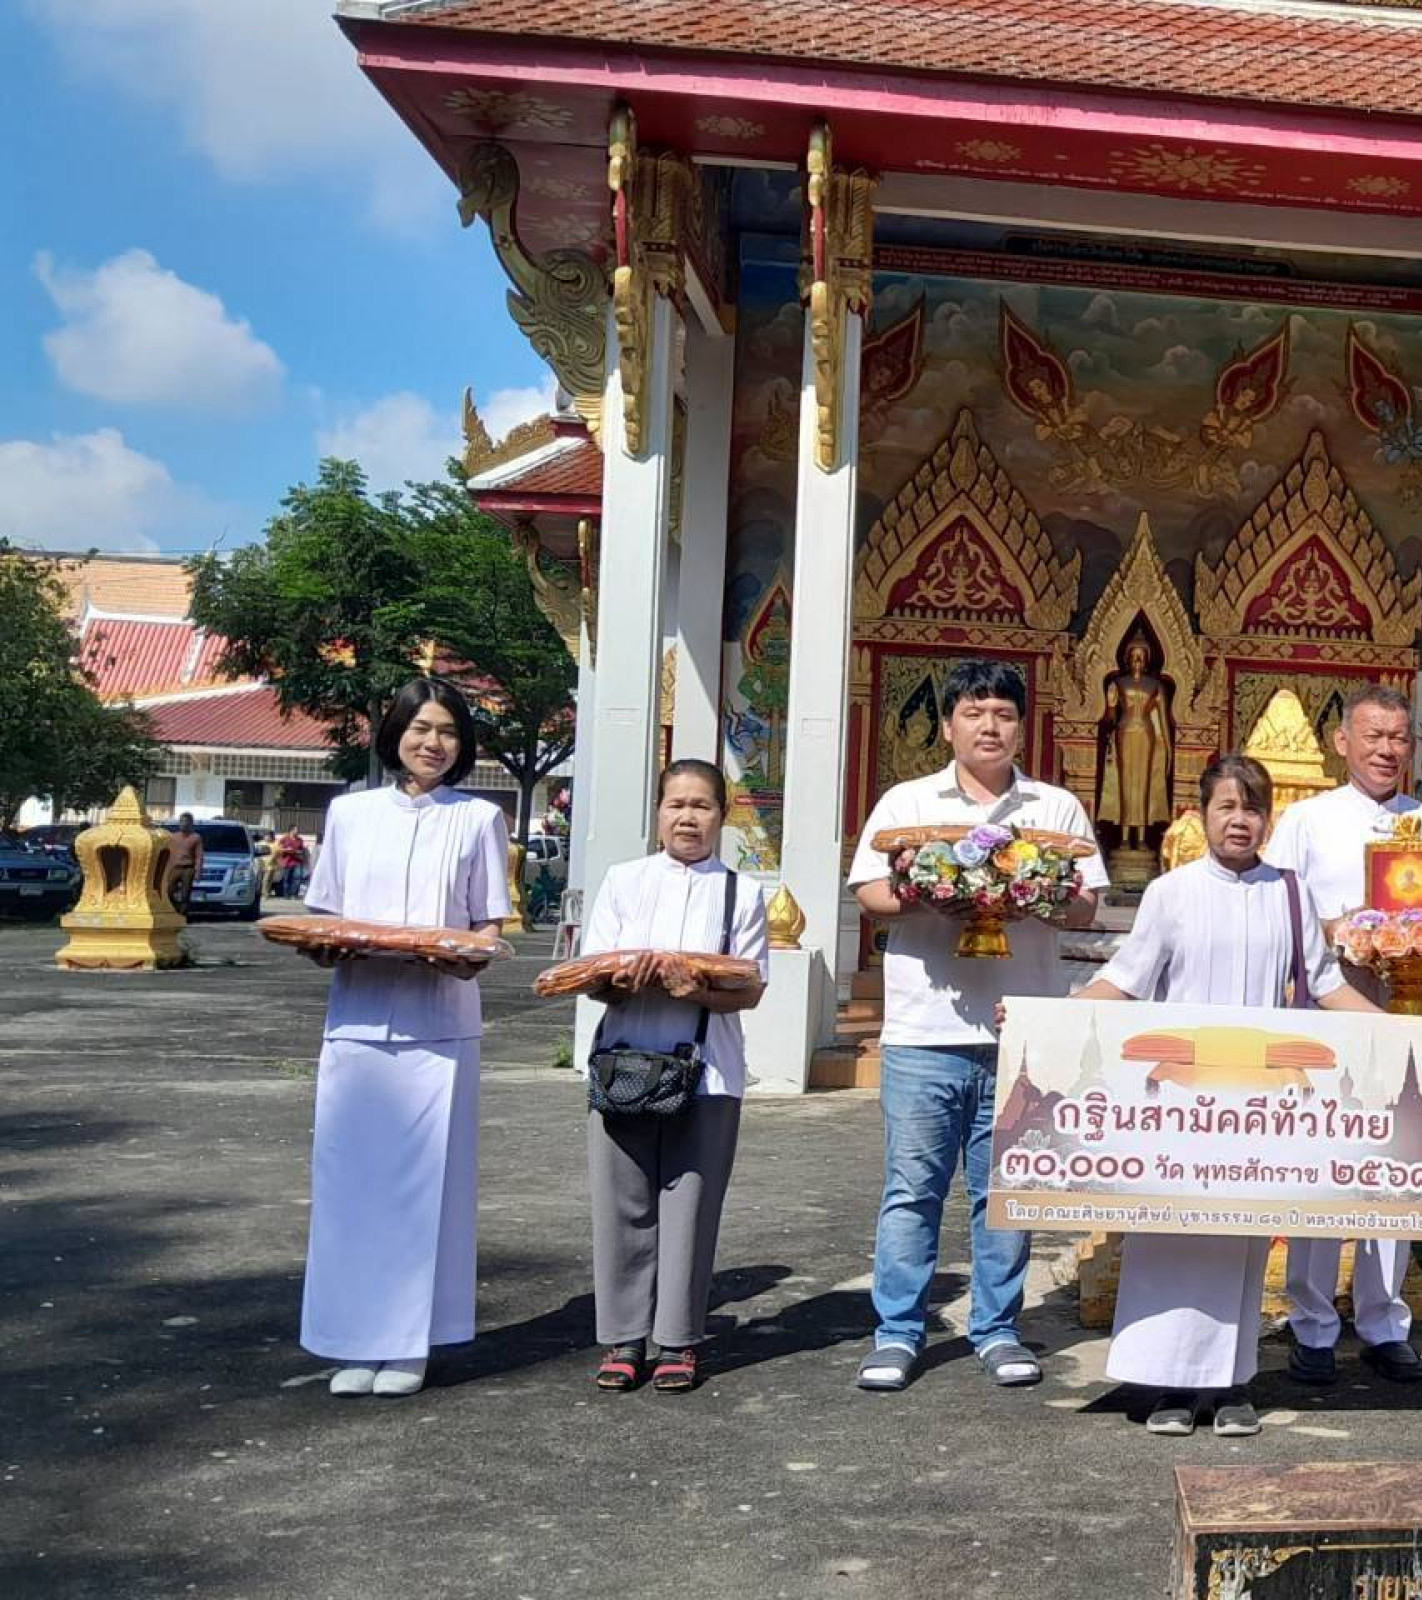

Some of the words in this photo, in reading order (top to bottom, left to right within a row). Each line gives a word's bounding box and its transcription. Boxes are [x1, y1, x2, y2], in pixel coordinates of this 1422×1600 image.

[1058, 1088, 1389, 1141] กฐินสามัคคีทั่วไทย
[1006, 1153, 1145, 1181] ๓๐,๐๐๐
[1155, 1154, 1184, 1180] วัด
[1192, 1158, 1319, 1189] พุทธศักราช
[1007, 1201, 1037, 1218] โดย
[1044, 1204, 1172, 1226] คณะศิษยานุศิษย์
[1178, 1211, 1253, 1227] บูชาธรรม
[1289, 1209, 1299, 1226] ปี
